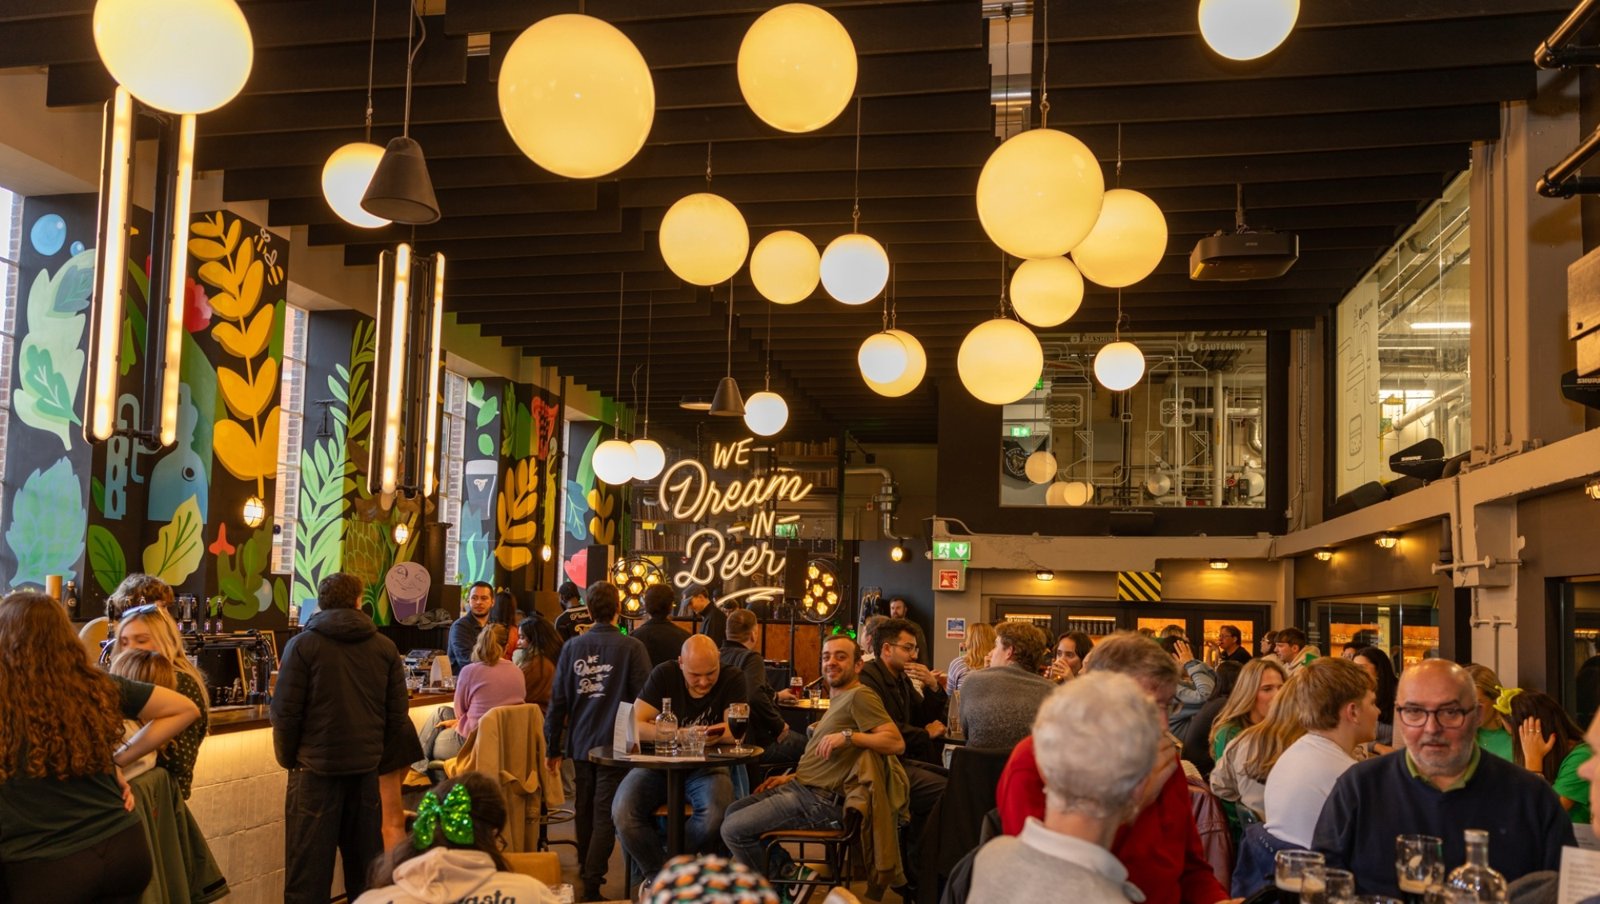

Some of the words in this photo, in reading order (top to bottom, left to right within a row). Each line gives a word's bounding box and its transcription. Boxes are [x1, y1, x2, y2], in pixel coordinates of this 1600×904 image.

[1200, 343, 1246, 351] LAUTERING
[713, 437, 753, 469] WE
[659, 459, 813, 523] Dream
[750, 510, 775, 538] IN
[674, 528, 786, 588] Beer
